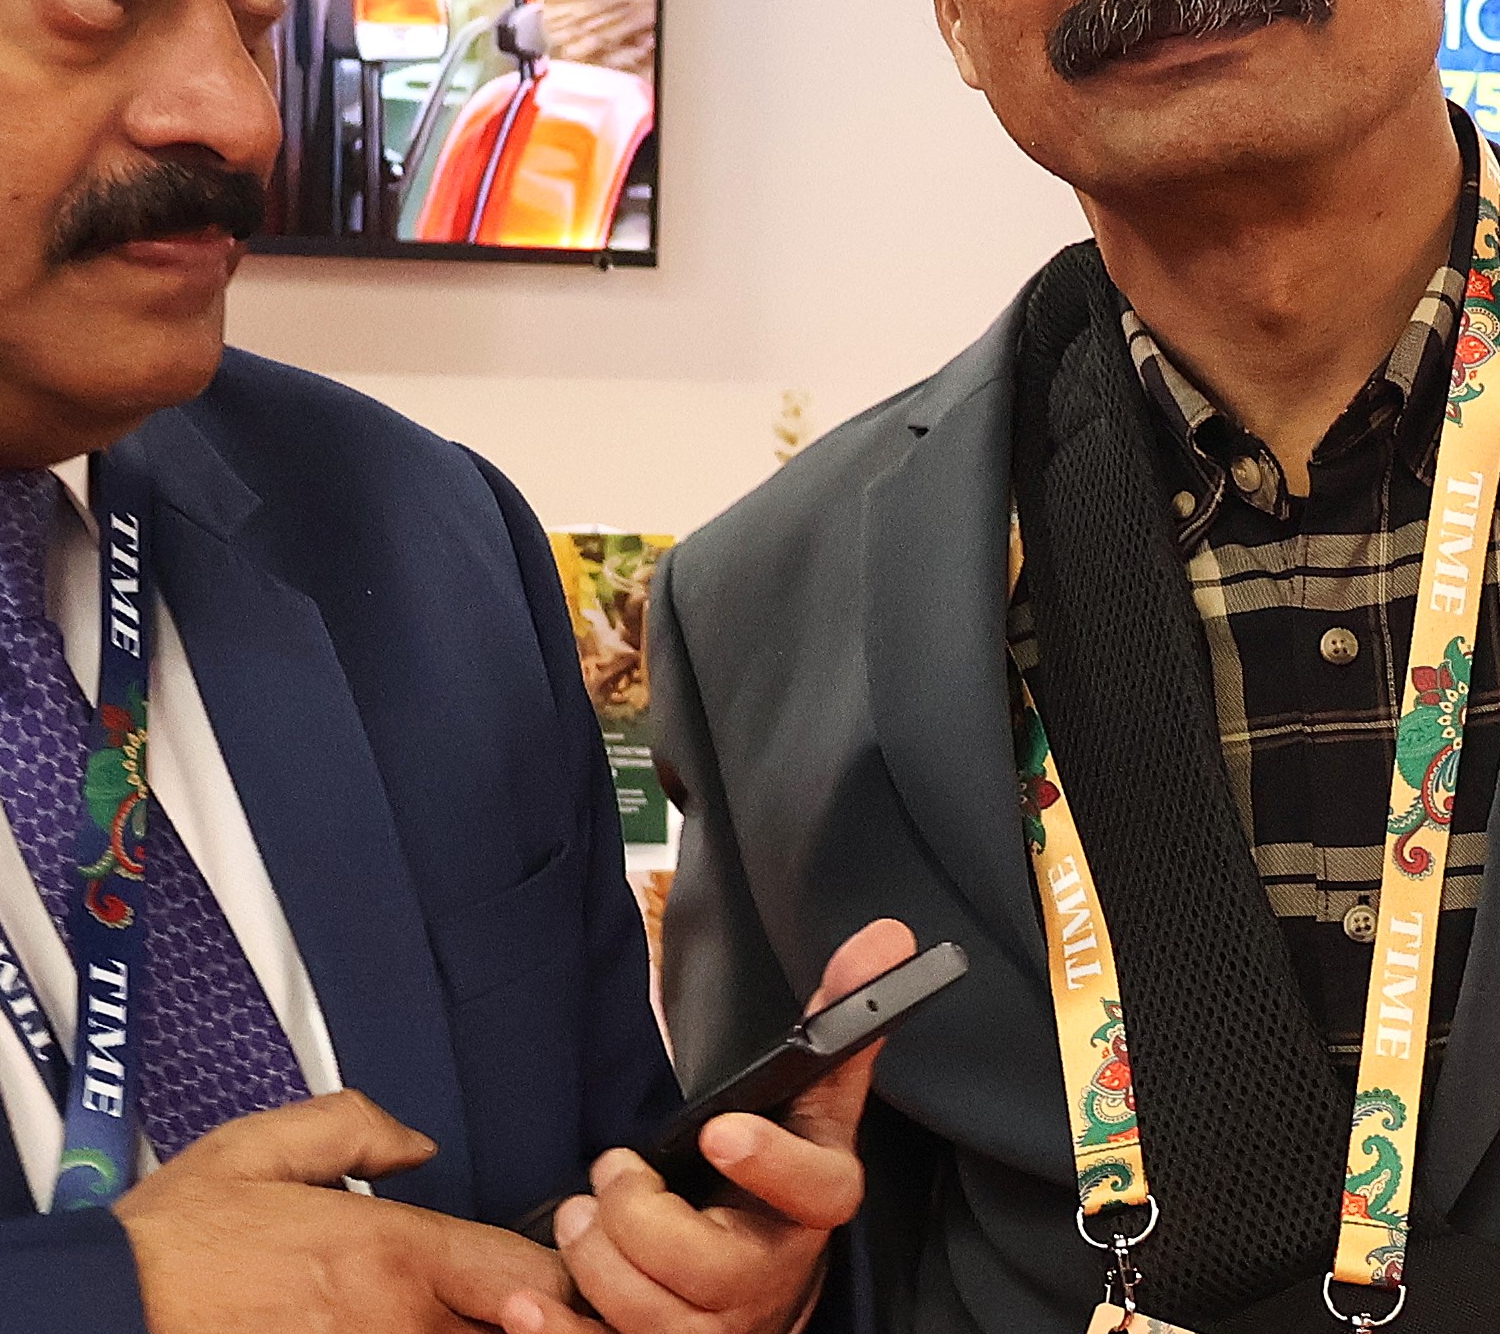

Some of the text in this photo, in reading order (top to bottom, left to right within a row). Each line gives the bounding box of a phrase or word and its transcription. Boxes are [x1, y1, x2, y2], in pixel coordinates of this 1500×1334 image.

[107, 511, 142, 660] TIME
[1428, 470, 1484, 616] TIME
[1047, 853, 1104, 990] TIME
[1374, 911, 1423, 1061] TIME
[81, 957, 133, 1119] TIME
